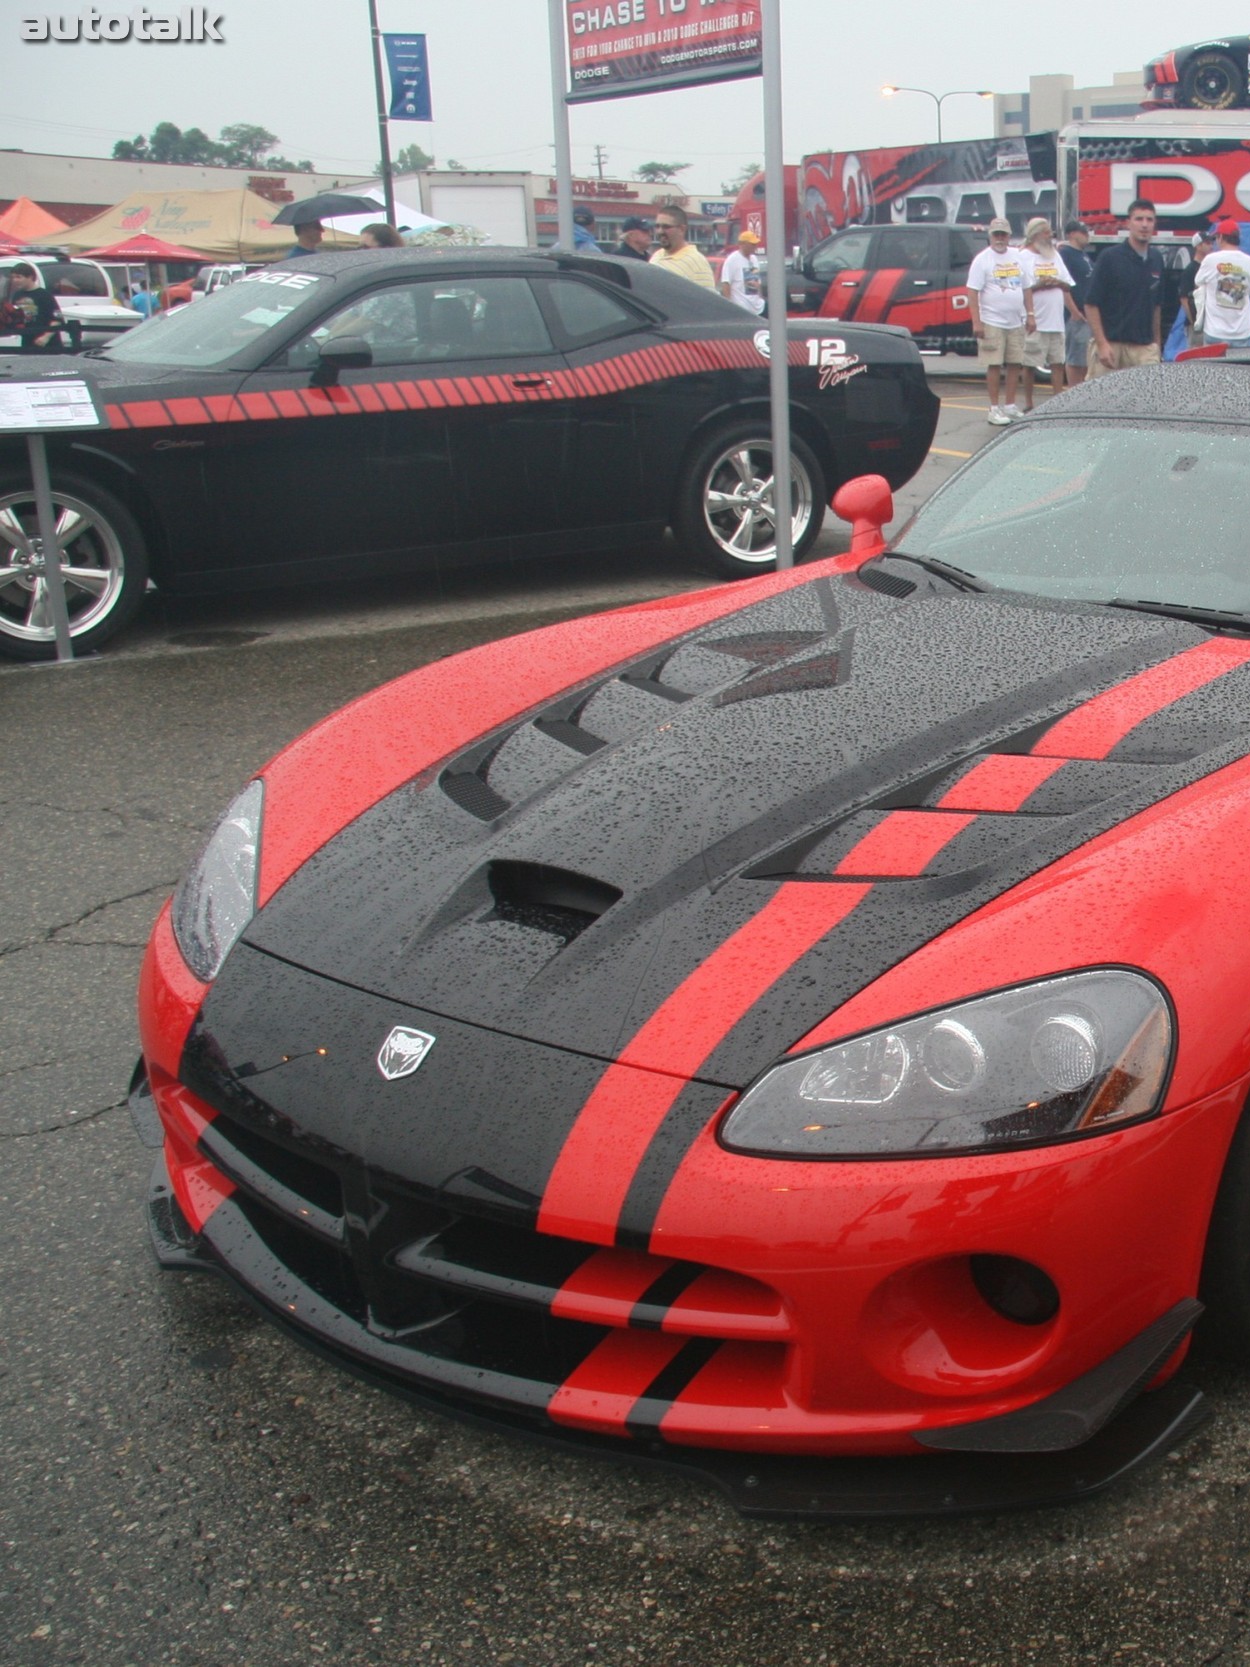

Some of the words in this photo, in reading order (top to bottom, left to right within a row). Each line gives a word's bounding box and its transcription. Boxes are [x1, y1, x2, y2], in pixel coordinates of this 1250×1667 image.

[572, 1, 645, 34] CHASE
[680, 22, 699, 39] DODGE
[701, 14, 739, 35] CHALLENGER
[661, 38, 757, 64] DODGEMOTORSPORTS.COM
[575, 66, 610, 80] DODGE
[806, 338, 846, 366] 12
